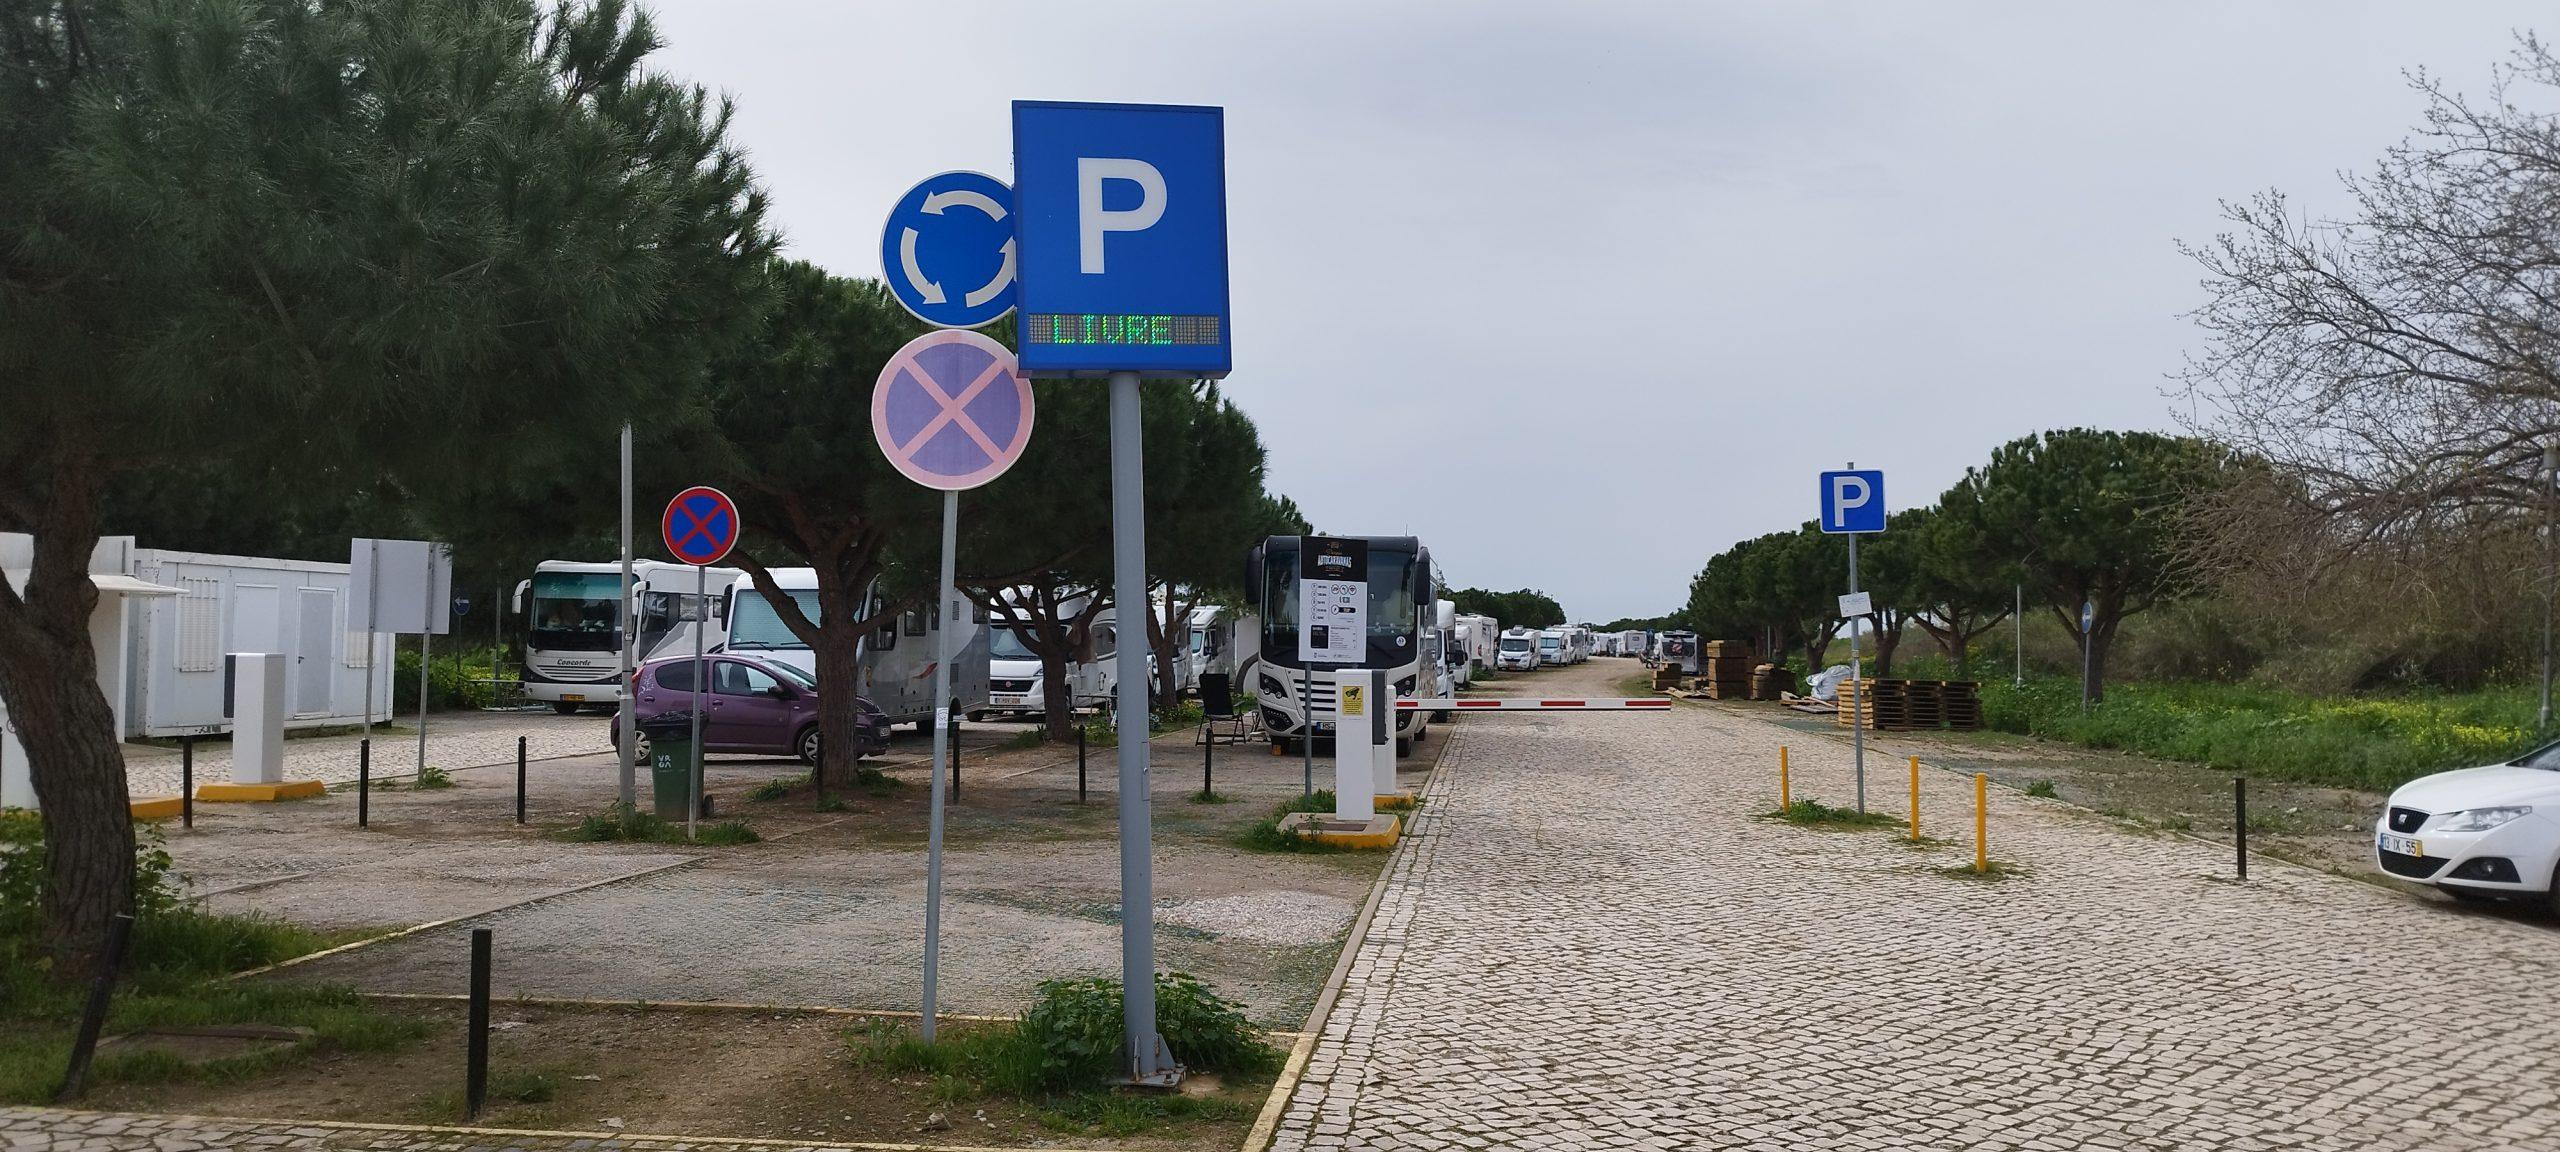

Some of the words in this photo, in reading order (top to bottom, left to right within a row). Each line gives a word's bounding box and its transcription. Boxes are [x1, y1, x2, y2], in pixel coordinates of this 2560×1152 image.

[1078, 157, 1168, 274] P
[1054, 314, 1172, 345] LIVRE
[1834, 476, 1870, 526] P
